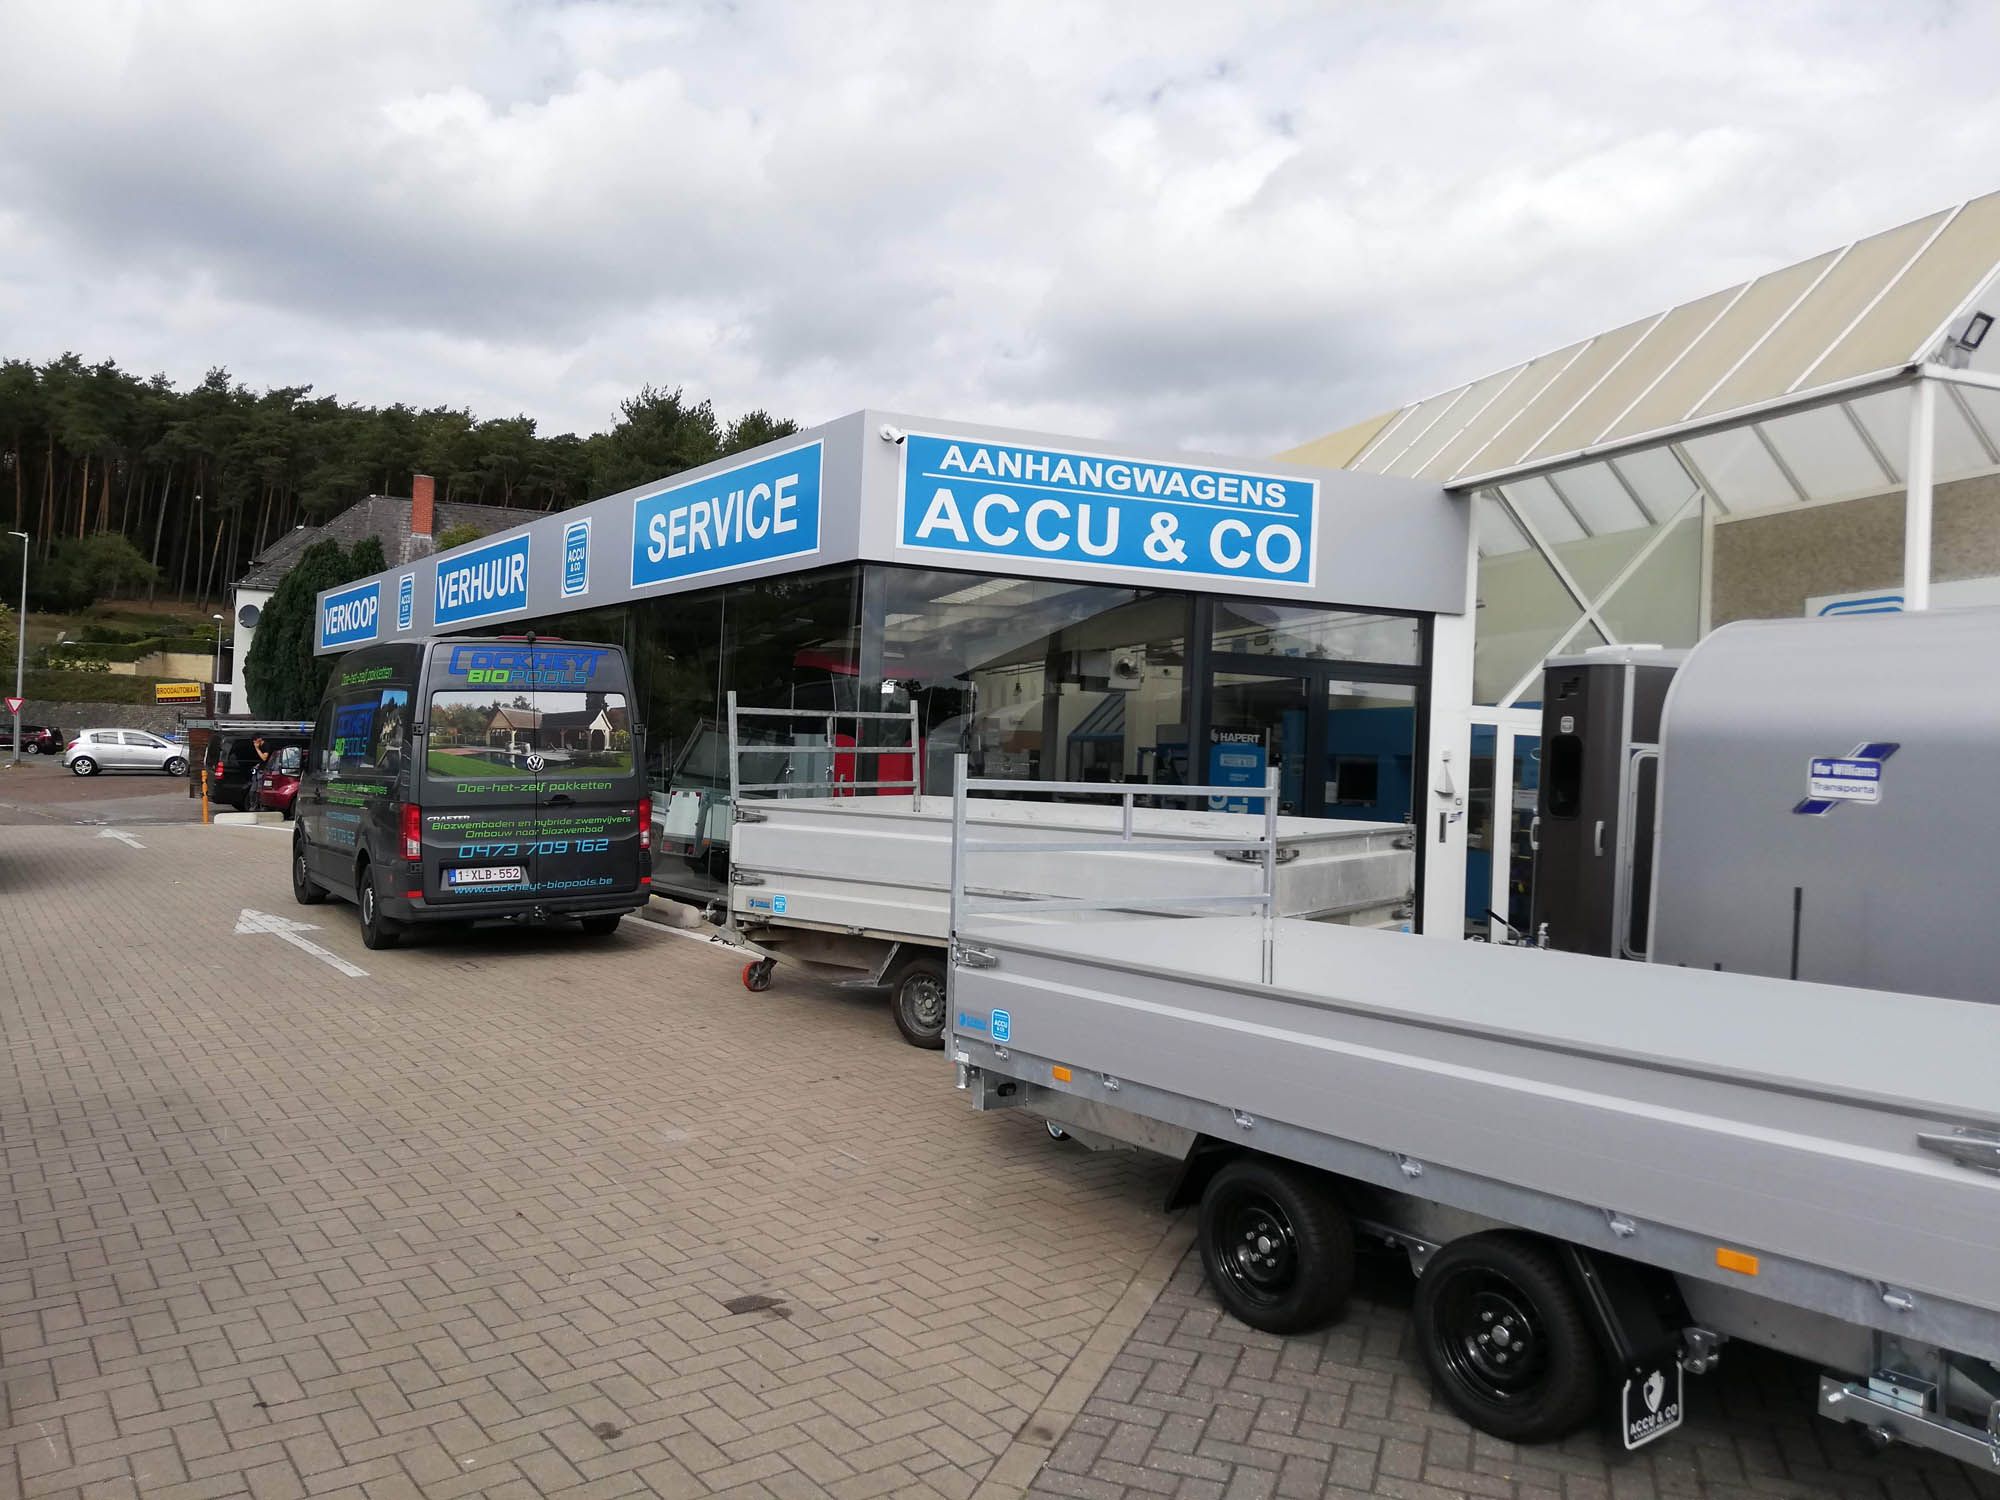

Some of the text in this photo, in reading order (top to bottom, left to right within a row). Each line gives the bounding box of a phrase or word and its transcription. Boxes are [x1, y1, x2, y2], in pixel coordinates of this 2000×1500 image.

[939, 445, 1286, 508] AANHANGWAGENS
[647, 473, 799, 563] SERVICE
[915, 487, 1301, 574] ACCU & CO
[567, 547, 585, 563] ACCU
[437, 552, 526, 610] VERHUUR
[324, 595, 378, 635] VERKOOP
[448, 645, 609, 678] COCKHEYT
[466, 669, 590, 685] BIOPOOLS
[1220, 732, 1261, 744] HAPERT
[548, 781, 612, 793] pakketten
[1812, 782, 1875, 794] Transporta
[431, 820, 515, 831] Biozwembaden
[533, 816, 573, 827] hybride
[575, 815, 631, 825] zwemvijvers
[465, 830, 512, 839] Ombouw
[541, 826, 604, 836] biozwembad
[458, 838, 609, 859] 0473 709 162
[454, 877, 613, 895] www.cockheyt-biopools.be
[1630, 1414, 1656, 1435] ACCU
[1665, 1403, 1678, 1418] CO
